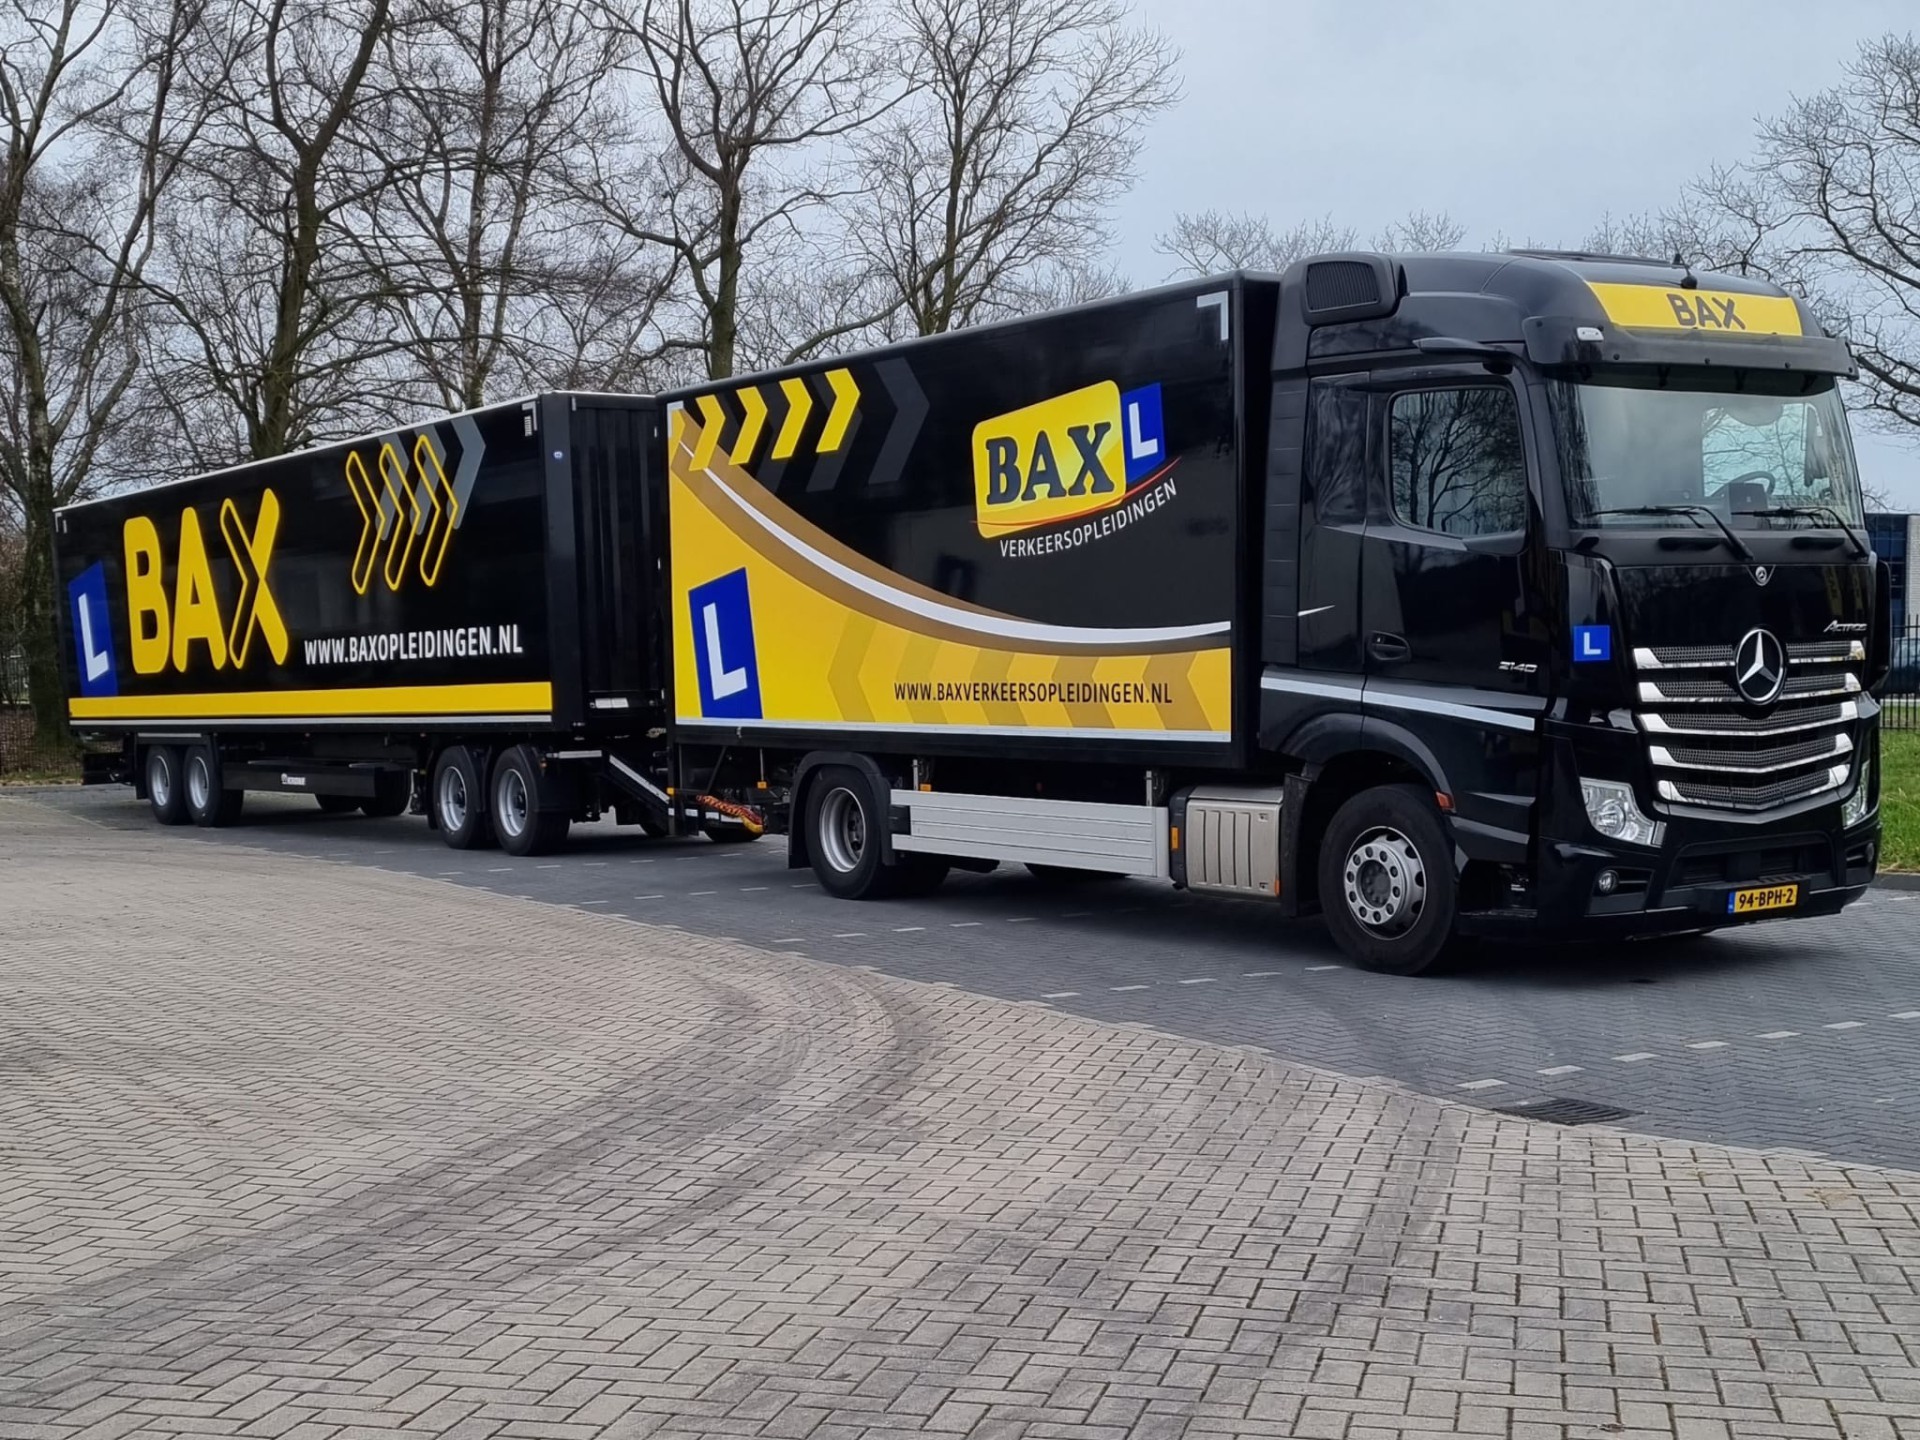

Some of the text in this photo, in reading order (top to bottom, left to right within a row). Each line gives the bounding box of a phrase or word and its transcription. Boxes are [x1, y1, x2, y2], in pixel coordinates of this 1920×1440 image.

[1666, 293, 1746, 330] BAX
[1128, 402, 1158, 459] L
[985, 421, 1115, 505] BAX
[1000, 477, 1177, 557] VERKEERSOPLEIDINGEN
[123, 488, 288, 674] BAX
[78, 592, 109, 682] L
[304, 624, 523, 665] WWW.BAXOPLEIDINGEN.NL
[703, 602, 748, 700] L
[1583, 632, 1602, 655] L
[894, 682, 1173, 704] WWW.BAXVERKEERSOPLEIDINGEN.NL
[1738, 887, 1794, 909] 94-BPH-2
